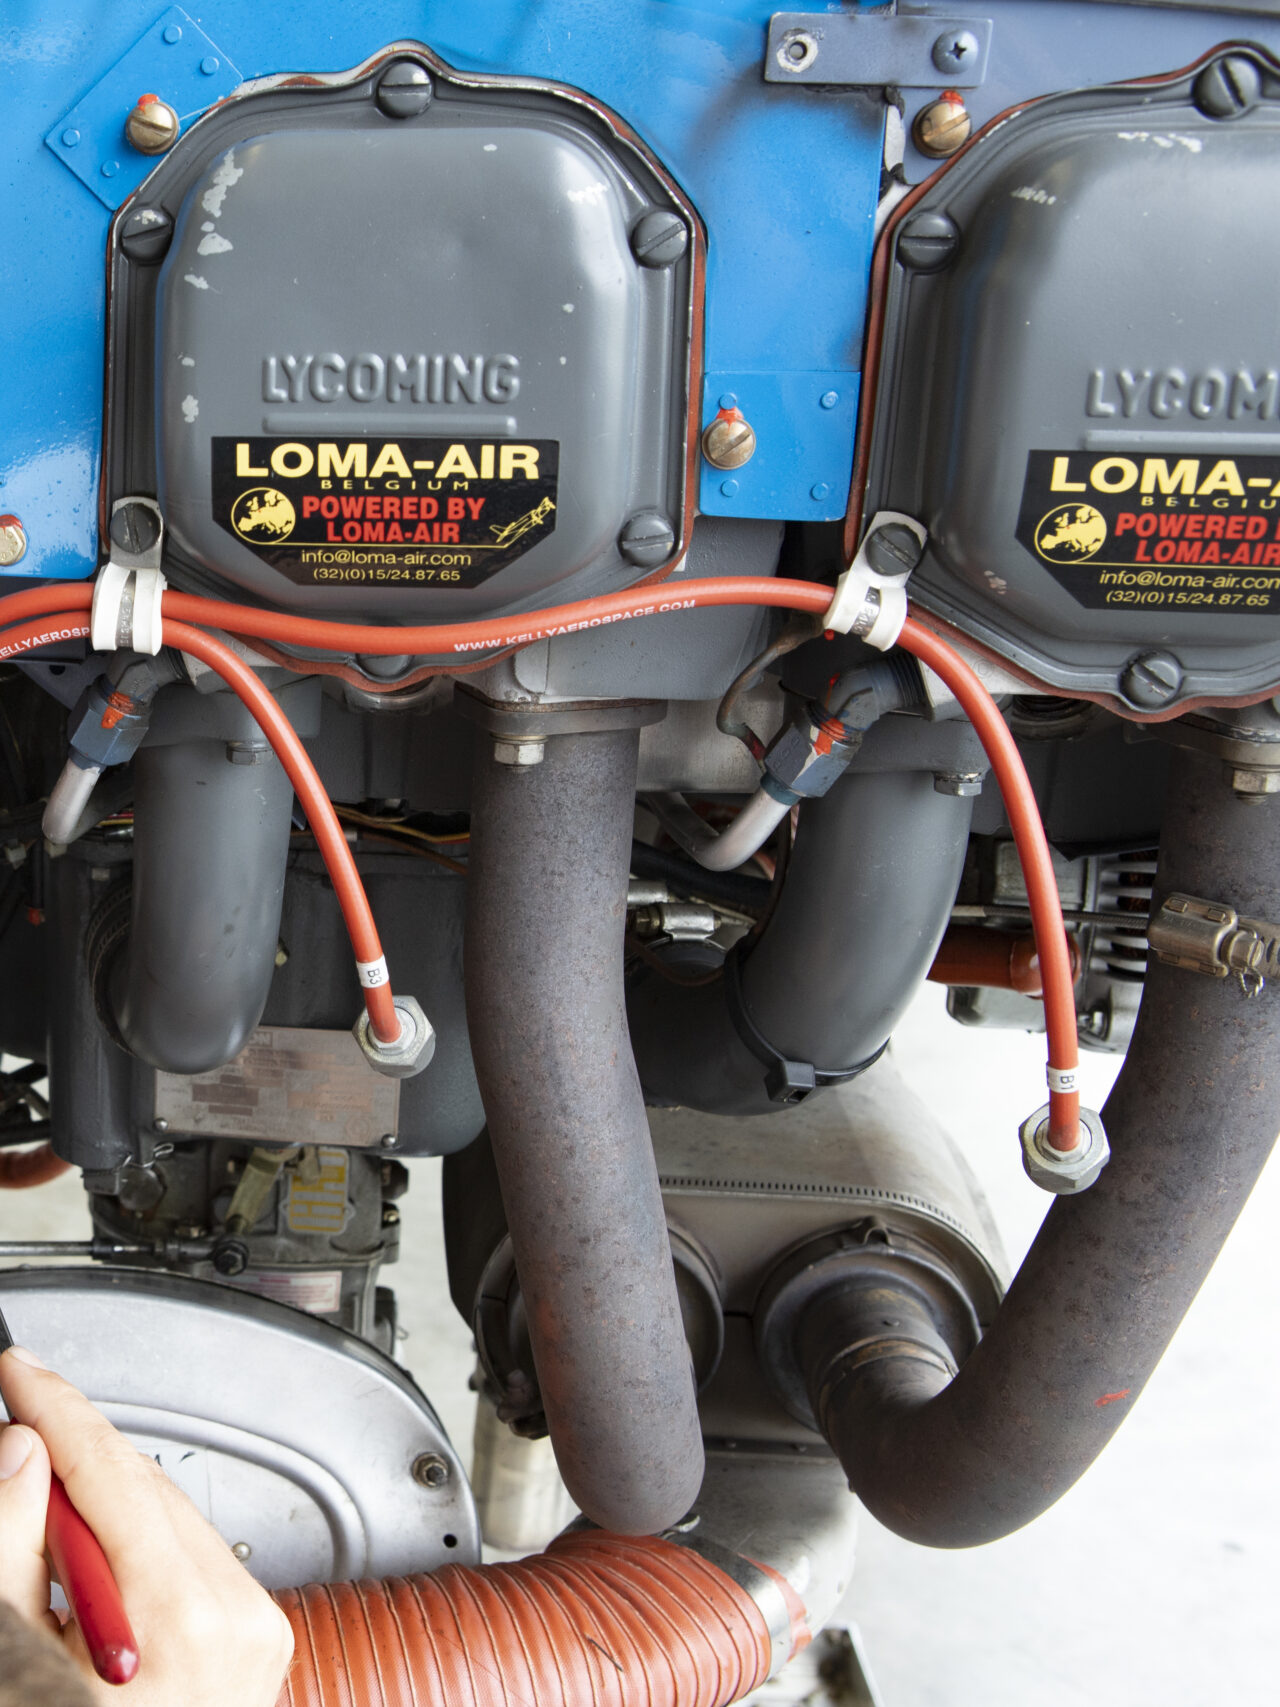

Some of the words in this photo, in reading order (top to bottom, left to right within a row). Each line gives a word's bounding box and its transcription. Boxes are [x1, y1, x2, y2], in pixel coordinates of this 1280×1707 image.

[262, 352, 520, 404] LYCOMING
[1086, 368, 1280, 420] LYCOM
[235, 442, 541, 480] LOMA-AIR
[321, 479, 470, 492] BELGIUM
[302, 495, 439, 520] POWERED
[447, 497, 486, 521] BY
[1140, 496, 1278, 510] BELGIU
[326, 521, 461, 544] LOMA-AIR
[1115, 513, 1268, 540] POWERED
[301, 550, 472, 567] info@loma-air.com
[313, 568, 461, 582] (32)(0)15/24.87.65
[1106, 590, 1270, 606] (32)(0)15/24.87.65
[454, 599, 696, 652] WWW.KELLYAEROSPACE.COM
